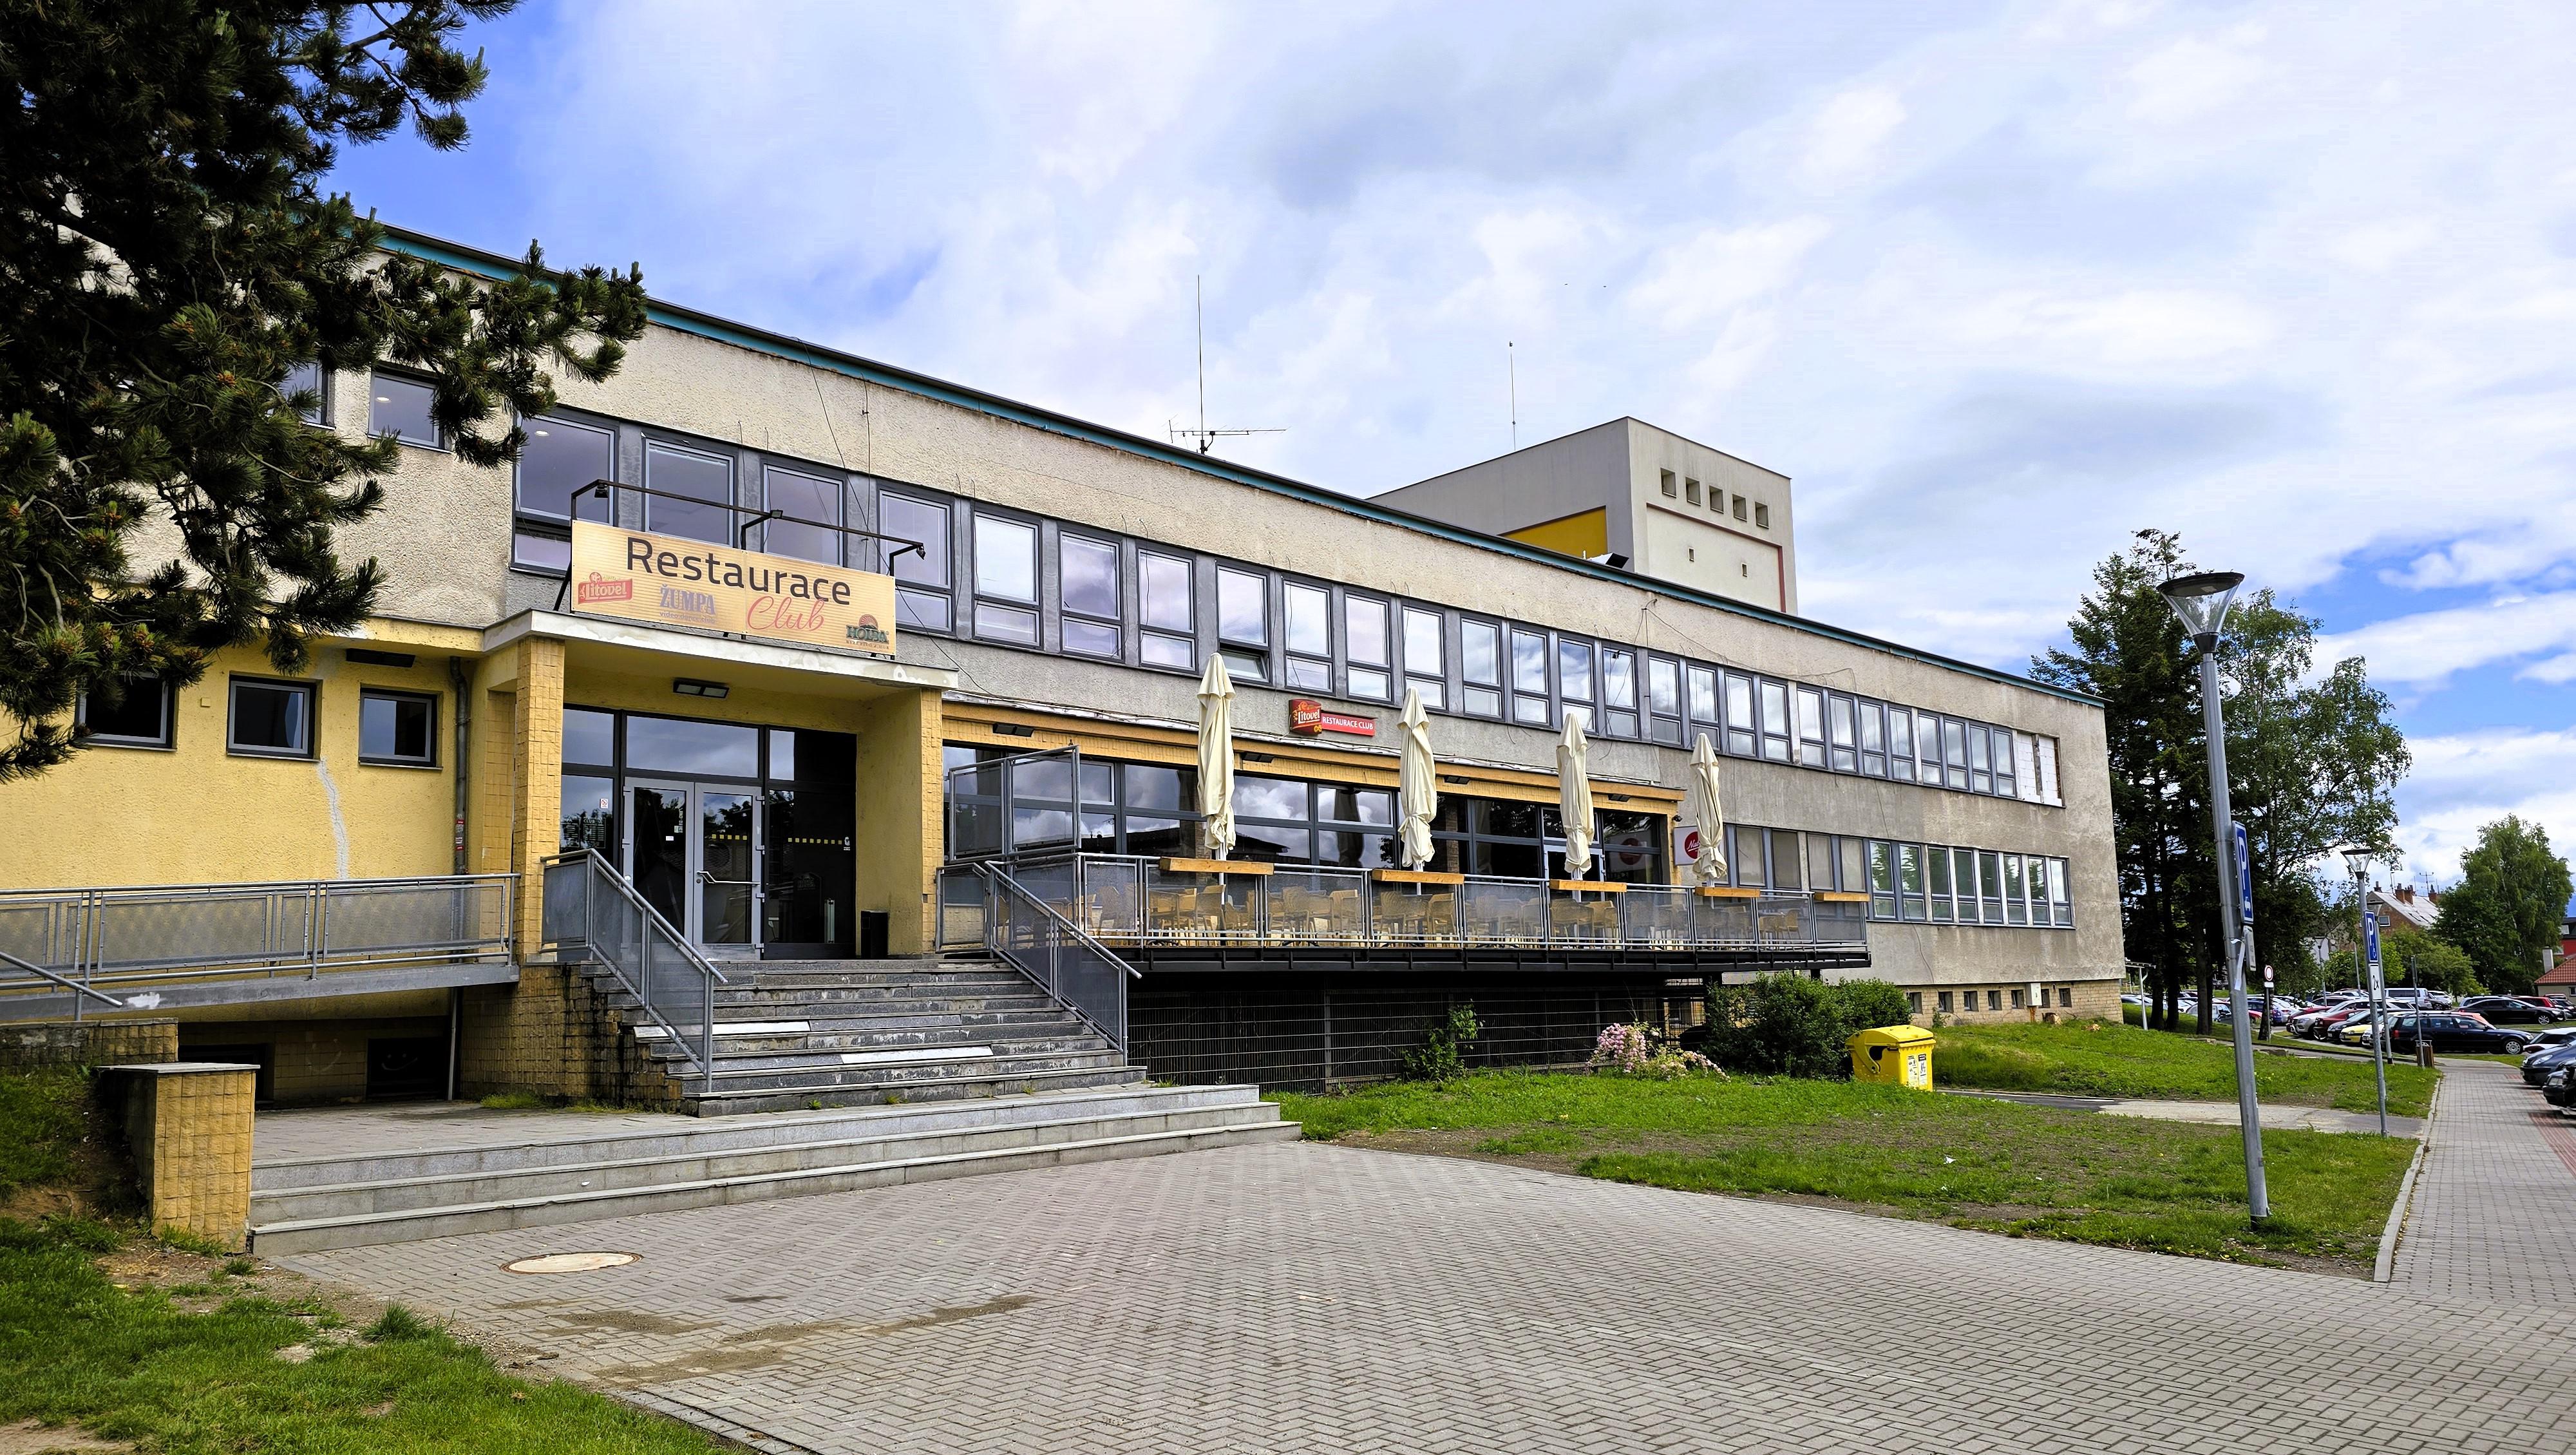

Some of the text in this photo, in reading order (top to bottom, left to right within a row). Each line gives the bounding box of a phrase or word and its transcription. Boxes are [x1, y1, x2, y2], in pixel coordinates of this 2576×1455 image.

[627, 536, 851, 605] Restaurace
[585, 581, 627, 600] Litovel
[659, 584, 715, 615] ŽUMPA
[747, 596, 824, 631] Club
[846, 624, 889, 644] HOLBA
[1298, 708, 1320, 724] Litovel
[1322, 716, 1374, 730] RESTAURACE CLUB
[2238, 836, 2247, 890] P
[2367, 917, 2374, 946] P
[2372, 975, 2380, 991] 2x
